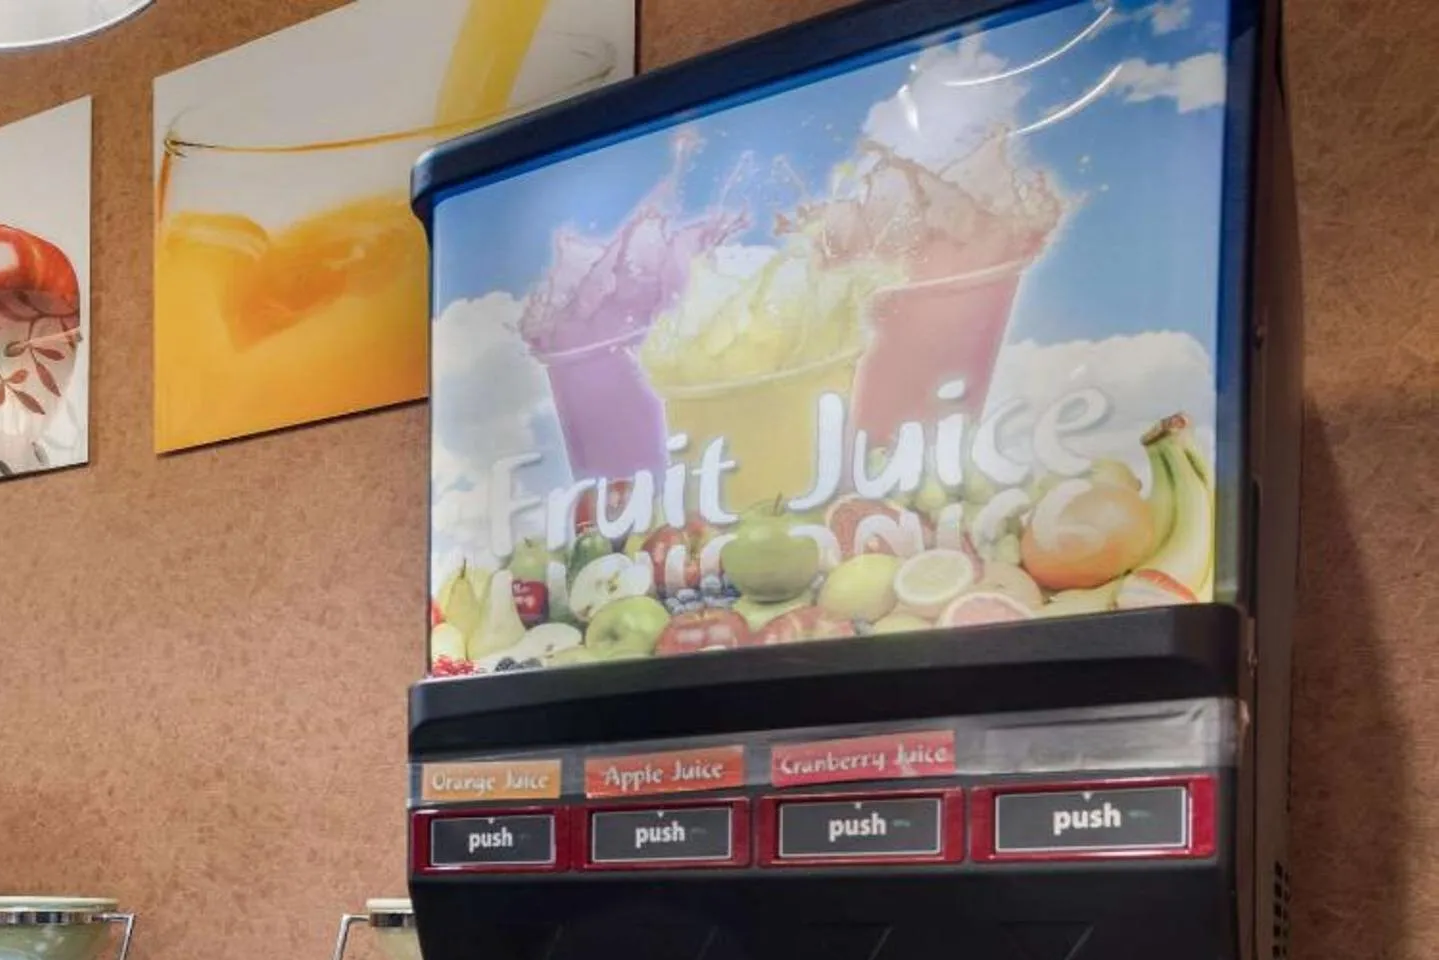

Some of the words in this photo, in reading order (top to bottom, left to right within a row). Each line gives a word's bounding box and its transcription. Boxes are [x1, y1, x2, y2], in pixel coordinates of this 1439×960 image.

[489, 434, 739, 557] Fruit
[788, 380, 1108, 510] Juice
[780, 750, 886, 776] Cranberry
[894, 743, 949, 767] Juice
[432, 771, 495, 796] Orange
[504, 769, 549, 790] Juice
[603, 766, 664, 790] Apple
[671, 760, 725, 782] Juice
[828, 811, 887, 842] push
[1053, 802, 1122, 836] push
[468, 826, 513, 853] push
[635, 820, 686, 849] push
